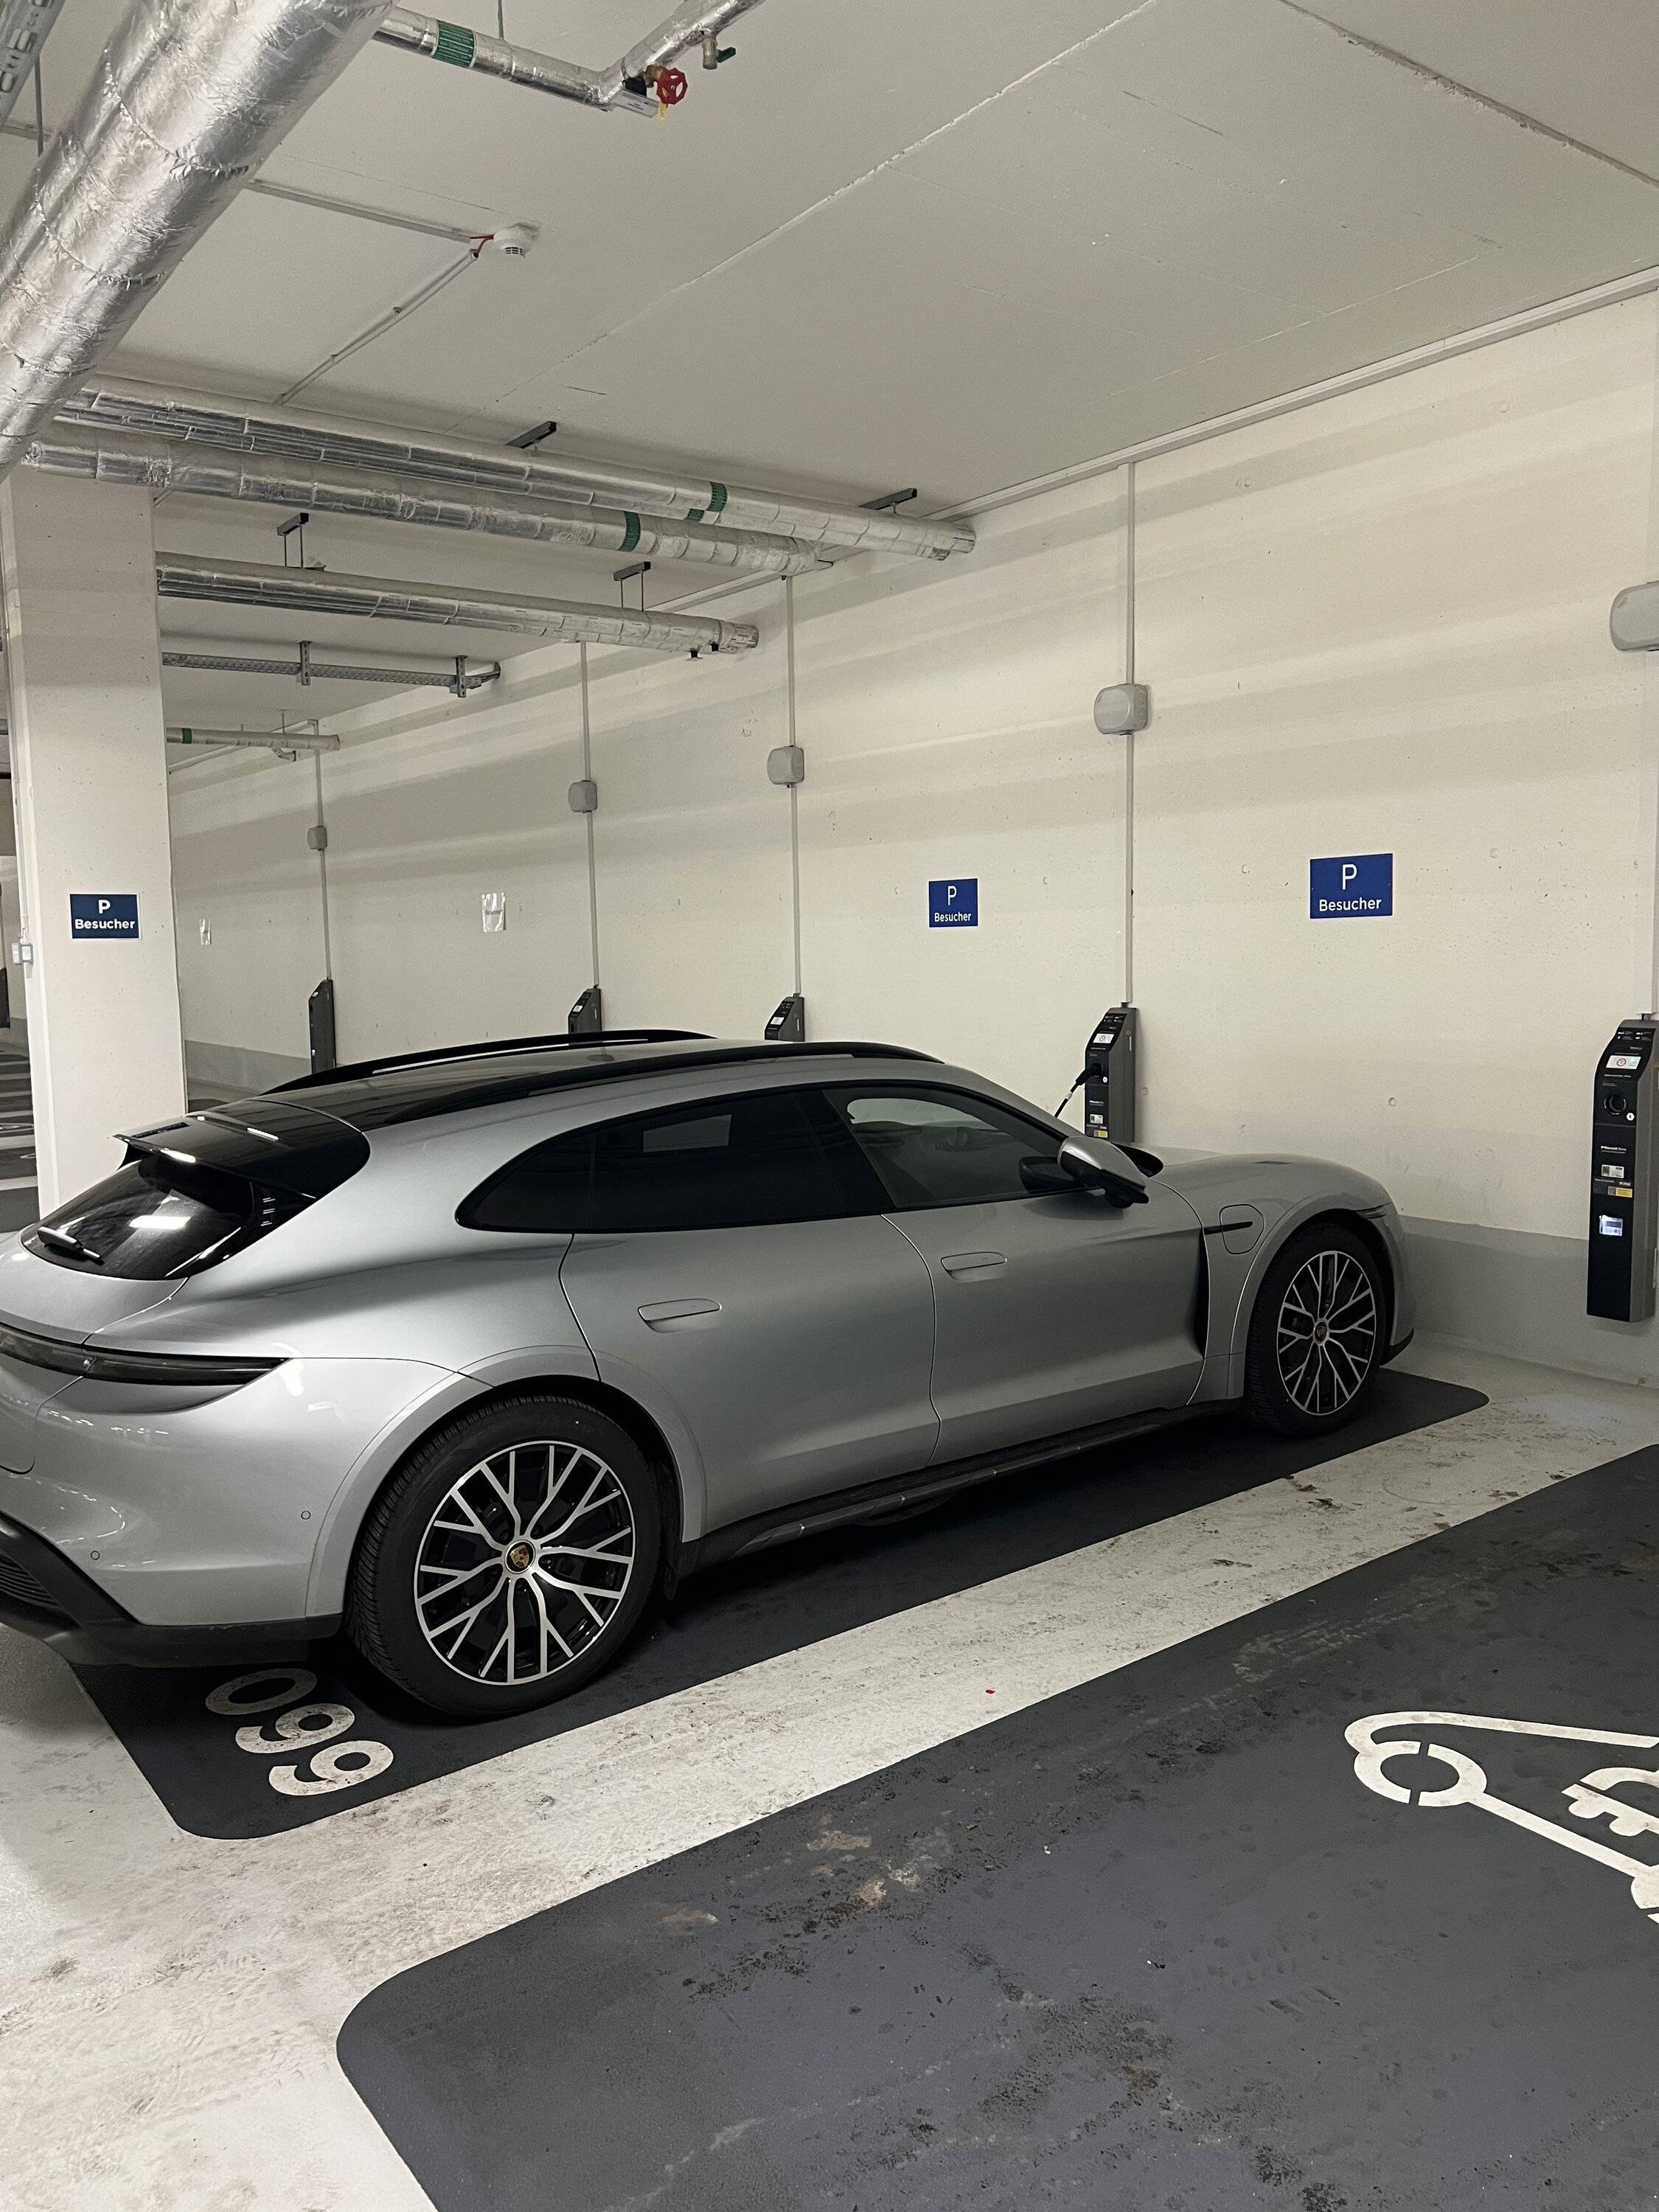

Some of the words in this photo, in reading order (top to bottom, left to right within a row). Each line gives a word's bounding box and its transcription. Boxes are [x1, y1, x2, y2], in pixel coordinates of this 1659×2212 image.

[1342, 863, 1357, 890] P
[947, 886, 957, 905] P
[98, 899, 111, 914] P
[1319, 897, 1382, 911] Besucher
[934, 911, 971, 922] Besucher
[74, 919, 136, 929] Besucher
